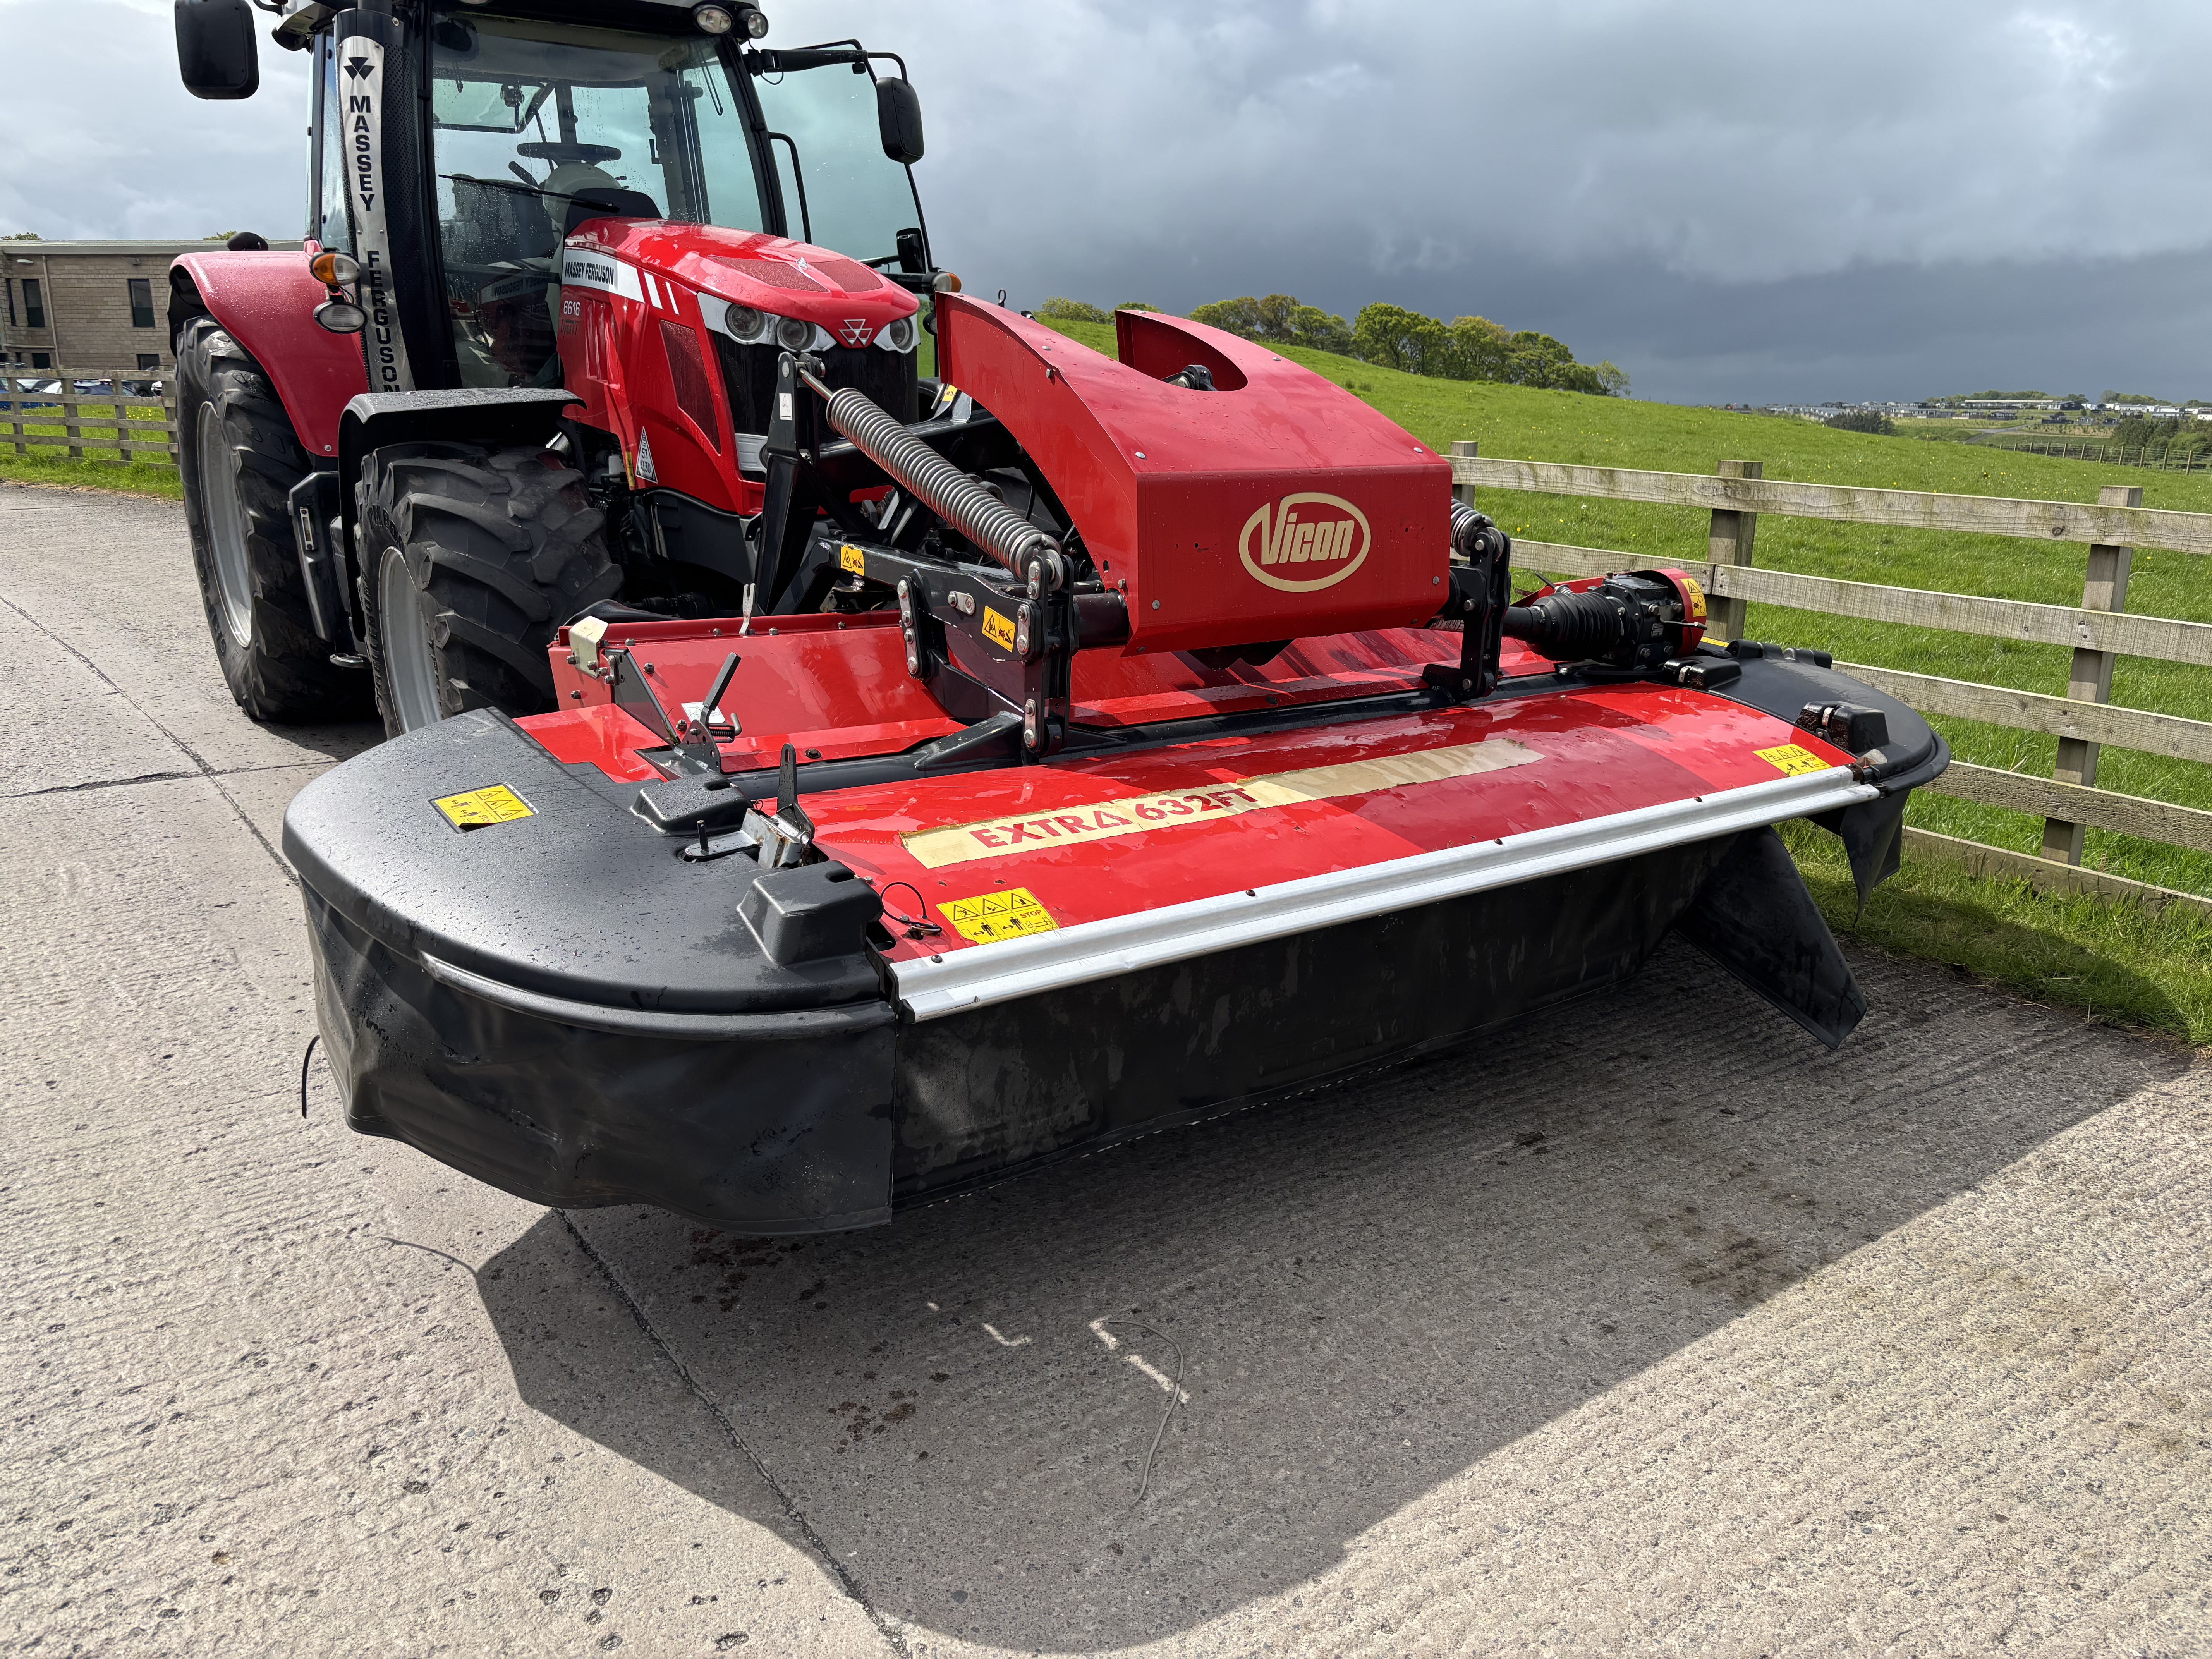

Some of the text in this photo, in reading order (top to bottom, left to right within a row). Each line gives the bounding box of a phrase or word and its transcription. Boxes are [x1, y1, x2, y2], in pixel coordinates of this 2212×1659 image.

[350, 96, 375, 211] MASSEY
[565, 262, 614, 285] MASSEY FERGUSON
[563, 301, 580, 316] 6616
[1261, 502, 1355, 565] Vicon
[969, 788, 1258, 848] EXTRA 632FT
[1020, 910, 1042, 919] STOP
